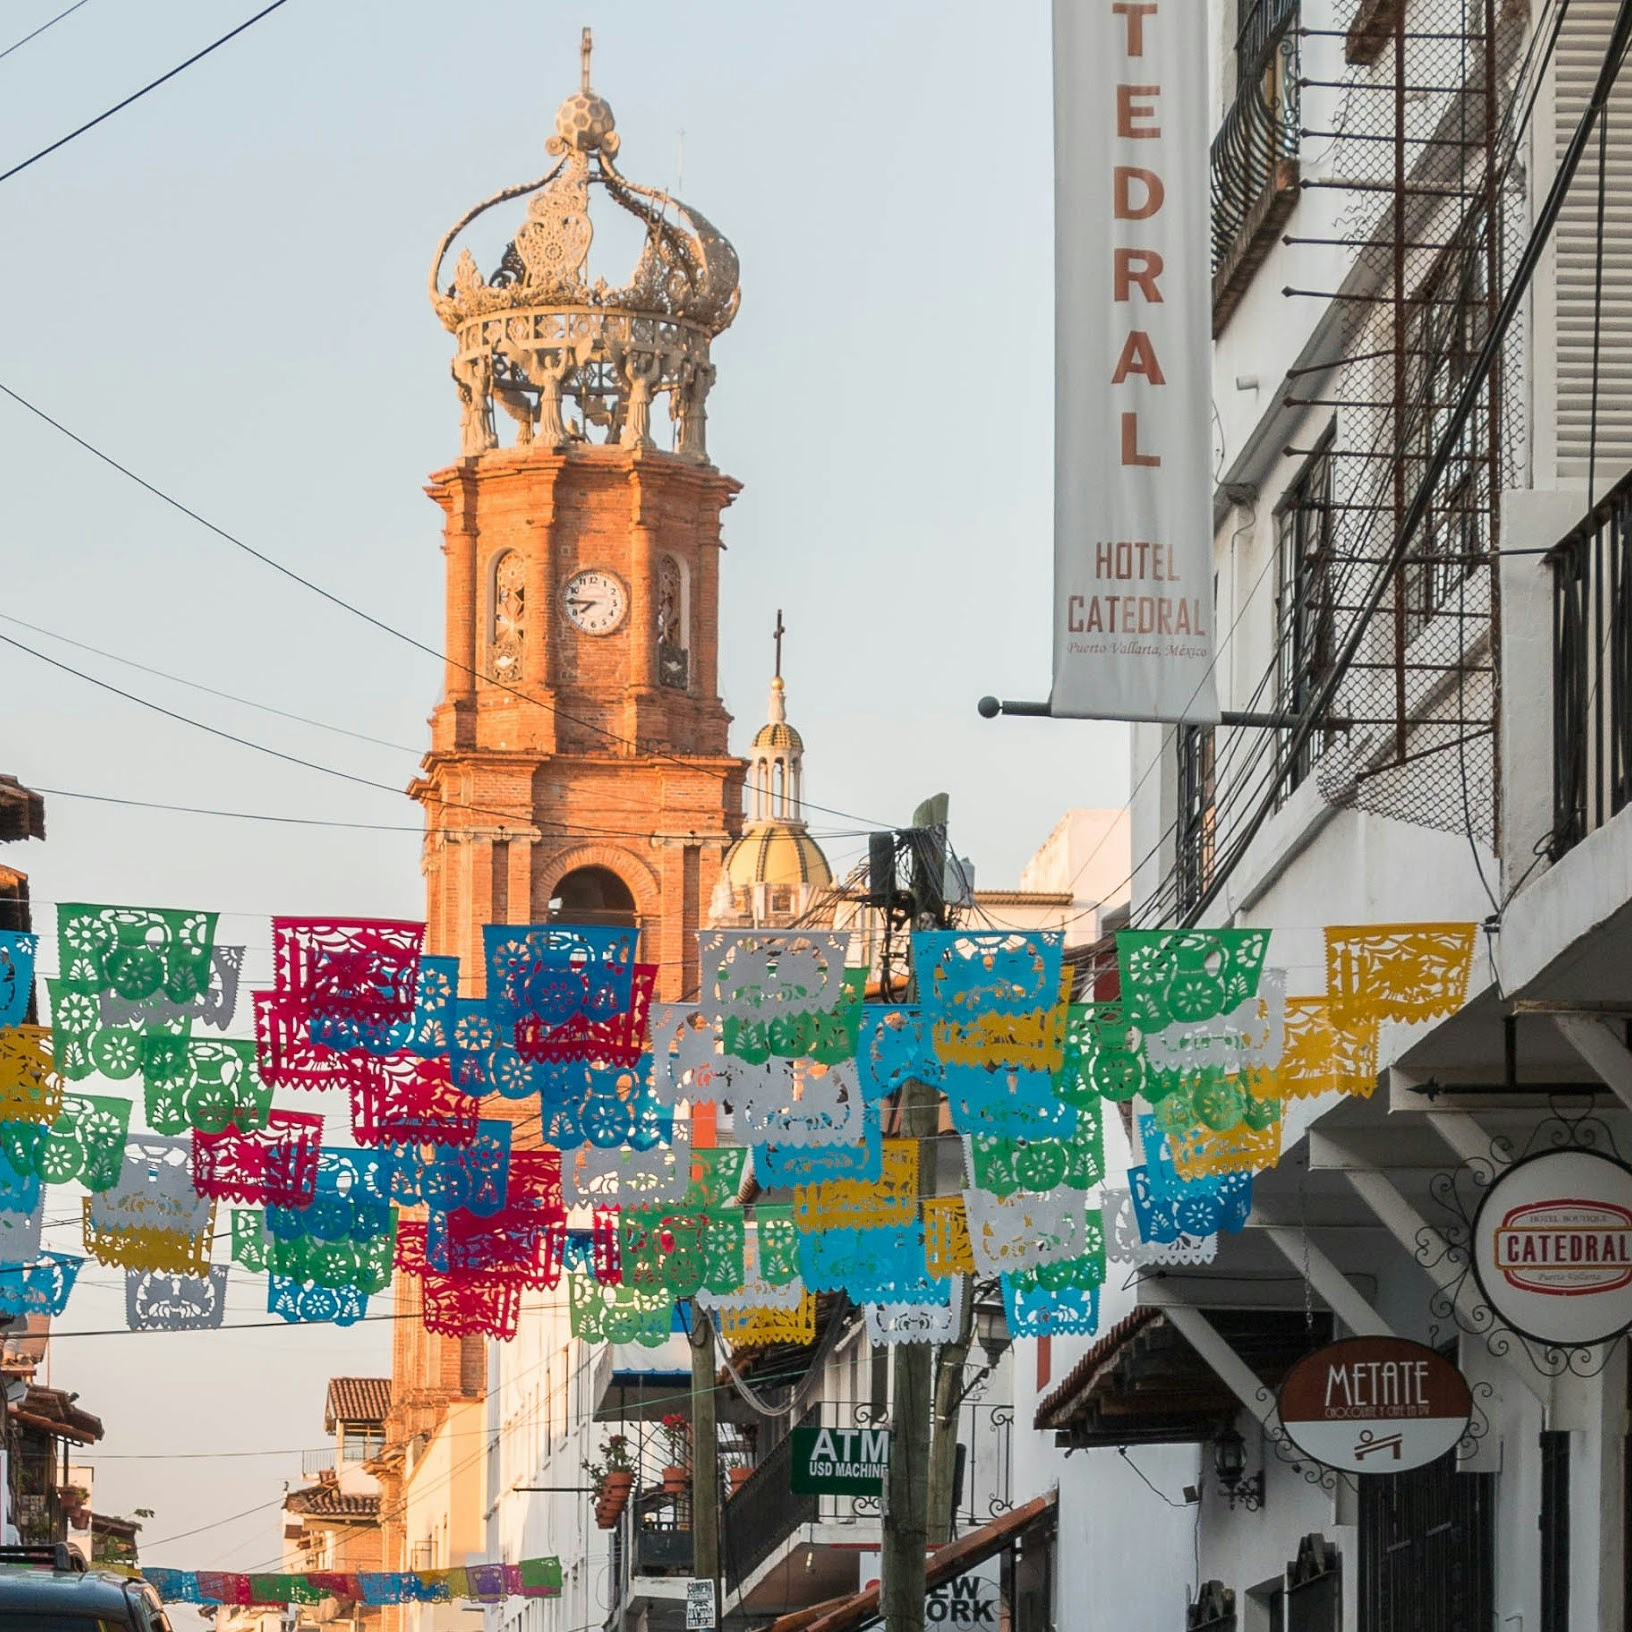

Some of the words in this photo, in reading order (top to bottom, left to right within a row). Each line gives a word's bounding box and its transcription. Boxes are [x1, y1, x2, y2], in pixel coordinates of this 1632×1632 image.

[1095, 541, 1181, 582] HOTEL
[1067, 594, 1206, 637] CATEDRAL
[1069, 642, 1107, 654] Puerto
[1112, 641, 1162, 657] Vallarta,
[1165, 643, 1207, 659] México
[1506, 1234, 1631, 1263] CATEDRAL
[1324, 1361, 1430, 1407] METATE
[809, 1429, 889, 1463] ATM
[809, 1461, 833, 1477] USD
[929, 1577, 981, 1600] EW
[925, 1599, 997, 1623] ORK
